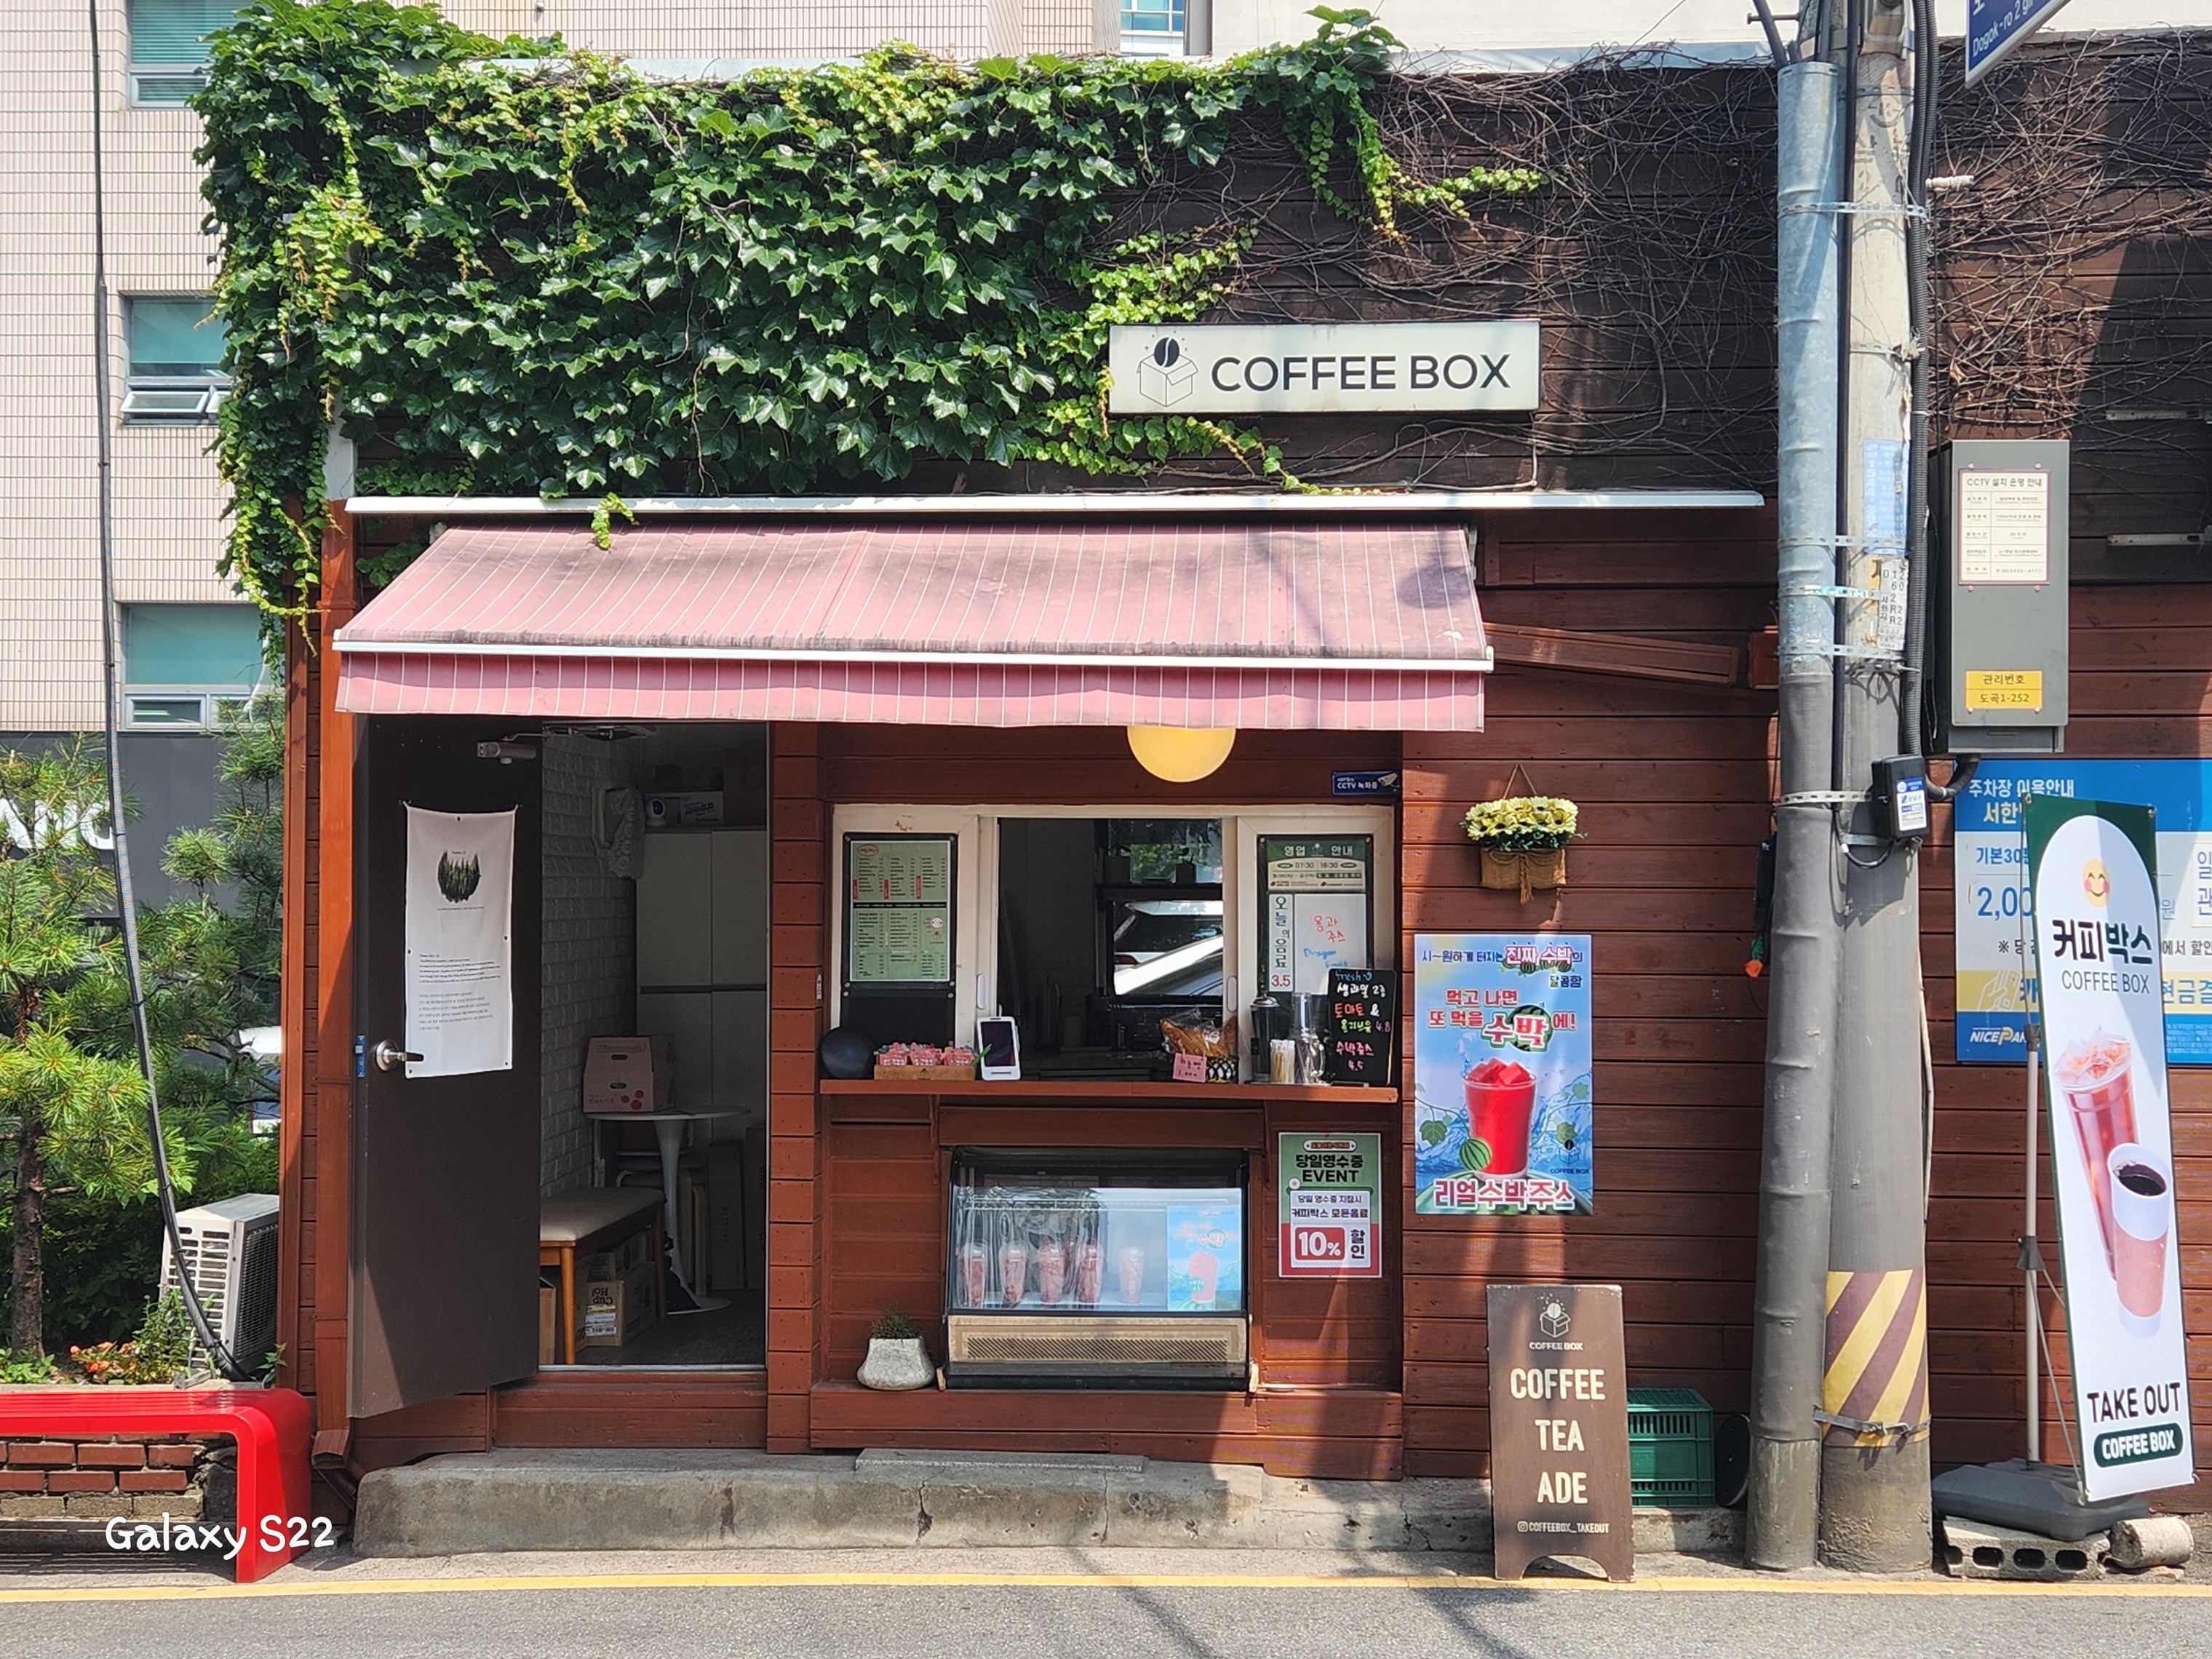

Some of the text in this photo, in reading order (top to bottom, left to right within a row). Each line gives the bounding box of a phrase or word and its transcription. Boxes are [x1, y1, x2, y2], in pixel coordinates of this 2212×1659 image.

[1973, 11, 2013, 57] Dogok-ro
[1211, 353, 1511, 391] COFFEE BOX
[1967, 478, 1990, 486] CCTV
[1992, 478, 2007, 487] 설치
[2027, 478, 2042, 487] 안내
[1982, 674, 2025, 685] 관리번호
[1979, 693, 2029, 704] 도곡1-252
[1968, 779, 2012, 797] 주차장
[1984, 801, 2022, 824] 서한
[1284, 846, 1353, 856] 영업 안내
[2052, 918, 2154, 966] 커피박스
[1275, 938, 1287, 968] 음료
[1505, 947, 1537, 964] 진짜
[1271, 974, 1291, 987] 3.5
[1334, 970, 1361, 982] fresh
[1550, 975, 1583, 987] 달콤함
[2061, 970, 2151, 994] COFFEE BOX
[1447, 989, 1518, 1006] 먹고 나면
[1334, 1003, 1364, 1018] 토마토
[1429, 1010, 1445, 1026] 또
[1450, 1010, 1484, 1027] 먹을
[1295, 1154, 1364, 1169] 당일영수증
[1302, 1169, 1359, 1182] EVENT
[1298, 1195, 1313, 1204] 당일
[1315, 1195, 1337, 1204] 영수증
[1434, 1179, 1575, 1209] 리얼수박주스
[1292, 1209, 1329, 1217] 커피박스
[1298, 1231, 1342, 1257] 10%
[1350, 1228, 1365, 1259] 할인
[1529, 1342, 1583, 1350] COFFEE BOX
[1510, 1368, 1606, 1400] COFFEE
[2087, 1382, 2181, 1423] TAKE OUT
[1535, 1420, 1585, 1451] TEA
[2101, 1429, 2176, 1460] COFFEE BOX
[1537, 1471, 1588, 1504] ADE
[1529, 1522, 1610, 1533] COFFEEBOX_TAKEOUT
